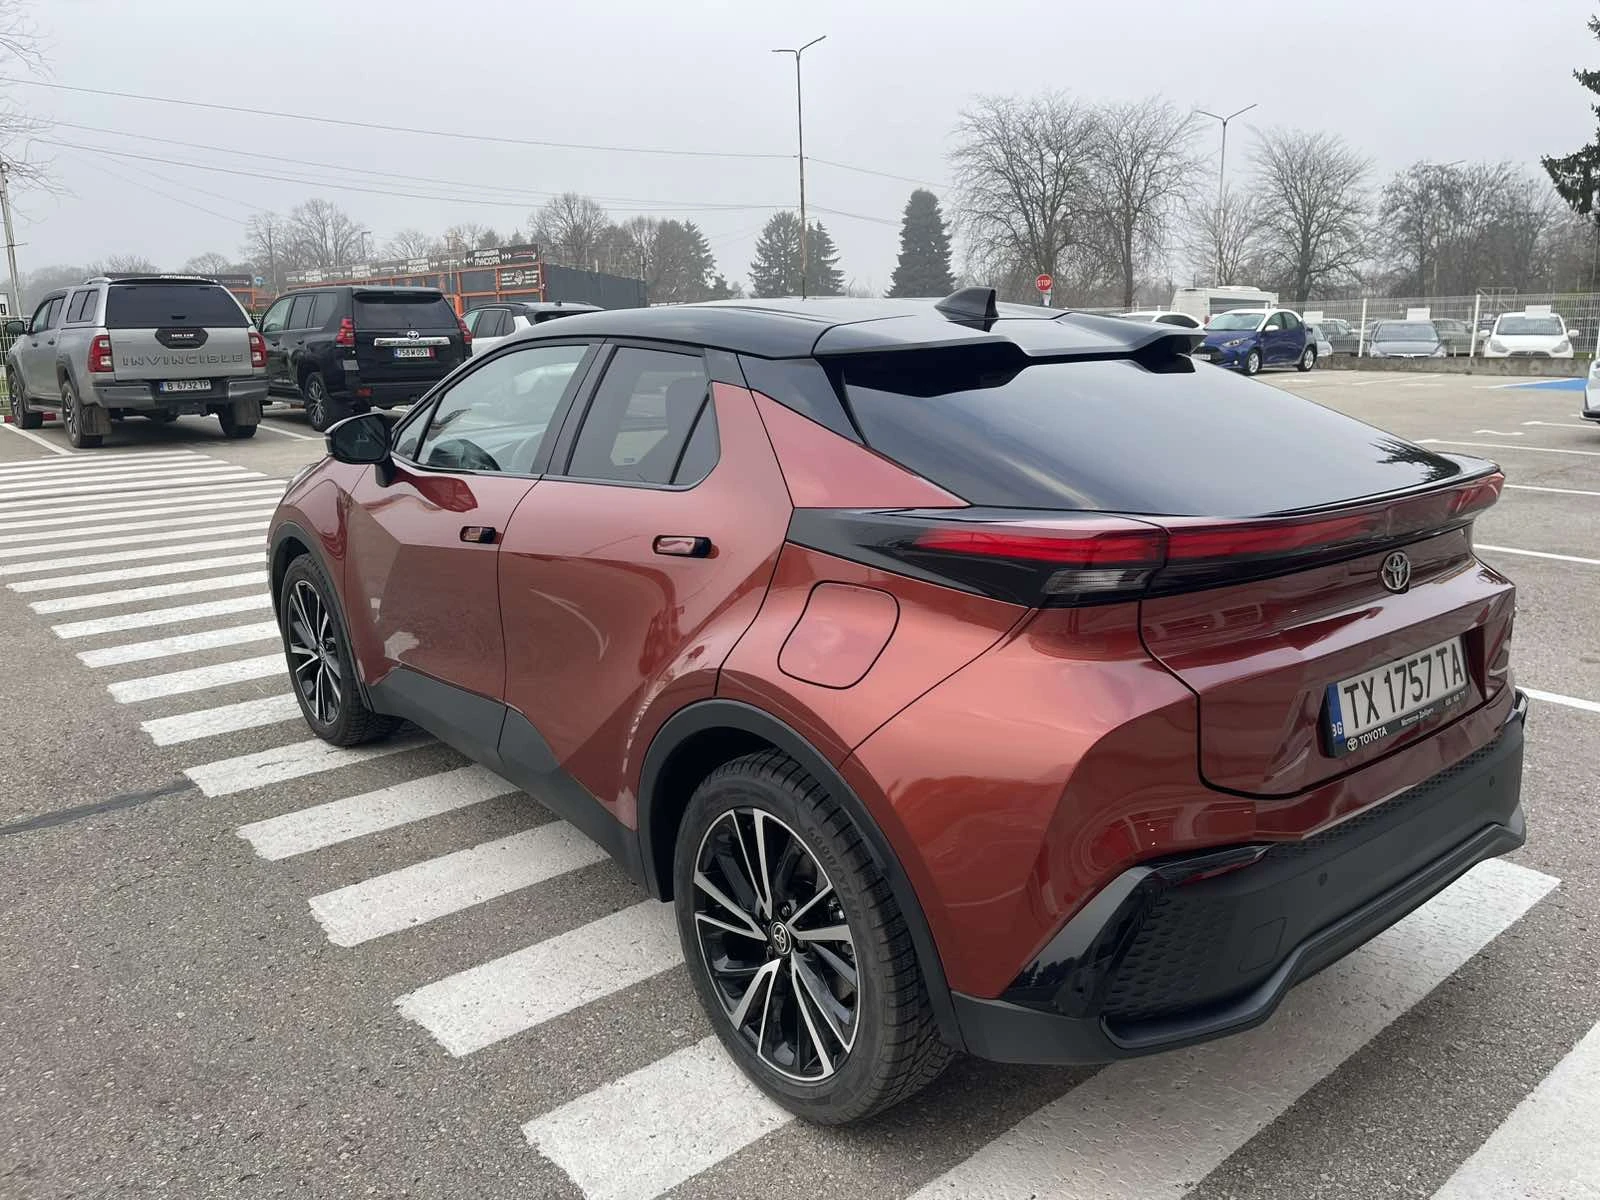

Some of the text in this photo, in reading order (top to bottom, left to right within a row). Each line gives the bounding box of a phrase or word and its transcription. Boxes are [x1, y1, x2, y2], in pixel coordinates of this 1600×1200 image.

[1037, 279, 1051, 287] STOP
[122, 353, 244, 367] INVINCIBLE
[1343, 677, 1380, 729] TX
[1384, 654, 1432, 714] 1757
[1435, 643, 1464, 690] TA
[1359, 726, 1388, 746] TOYOTA
